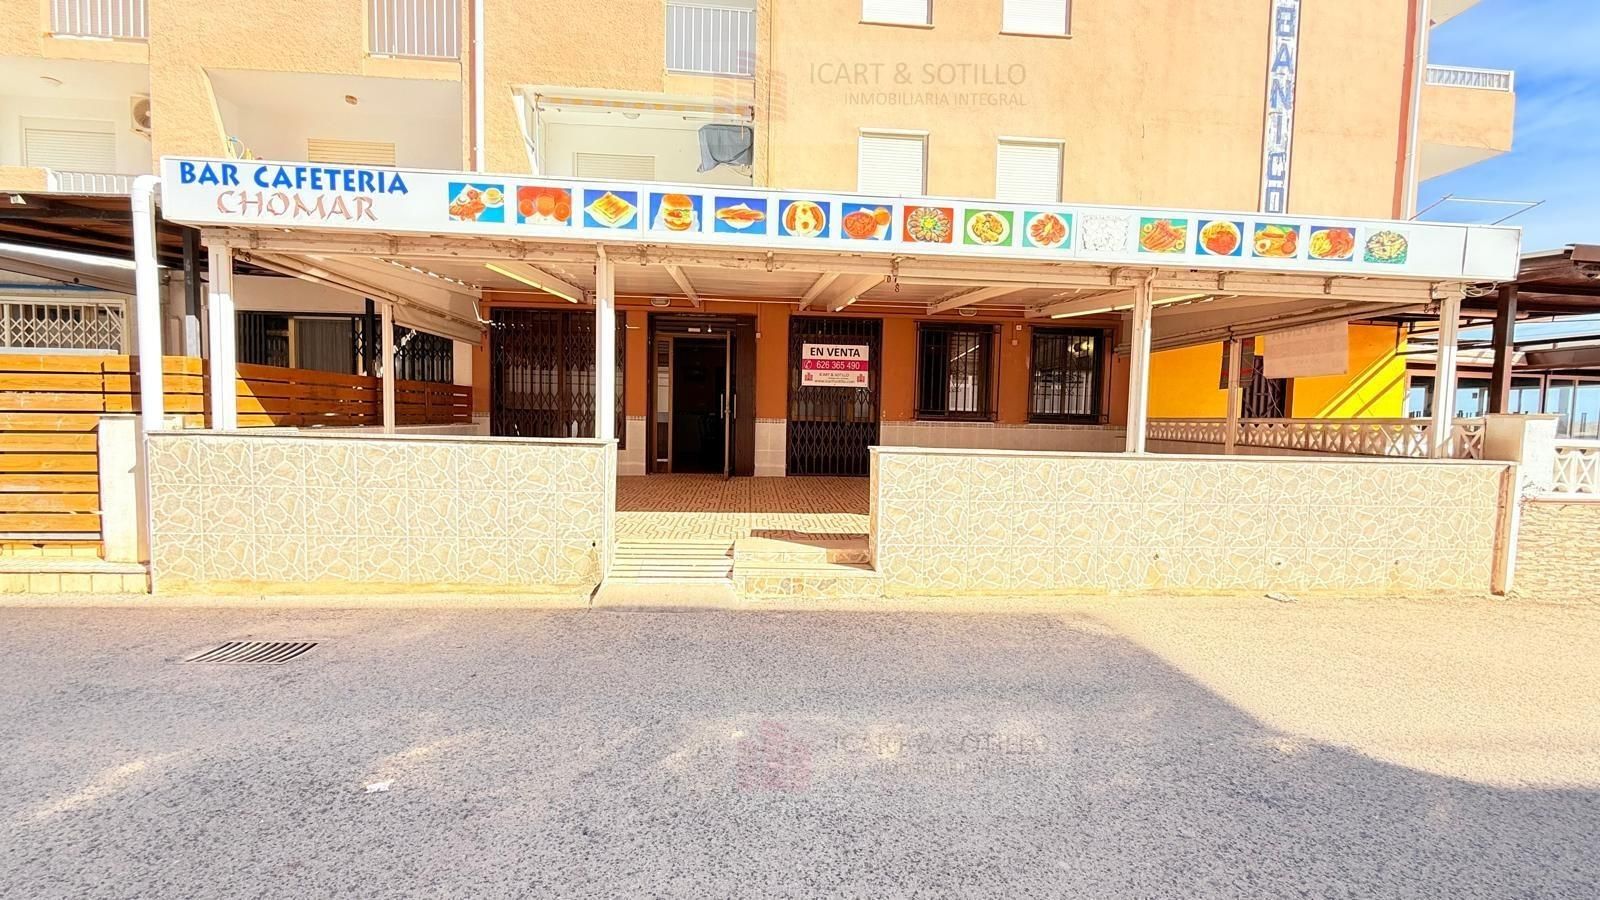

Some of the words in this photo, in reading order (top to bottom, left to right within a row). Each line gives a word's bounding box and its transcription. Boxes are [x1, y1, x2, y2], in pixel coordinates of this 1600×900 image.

[179, 161, 240, 187] BAR
[253, 165, 409, 196] CAFETERIA
[216, 190, 379, 222] CHOMAR
[810, 347, 823, 356] EN
[827, 348, 860, 357] VENTA
[816, 361, 830, 369] 626
[831, 361, 845, 369] 365
[846, 361, 860, 370] 490
